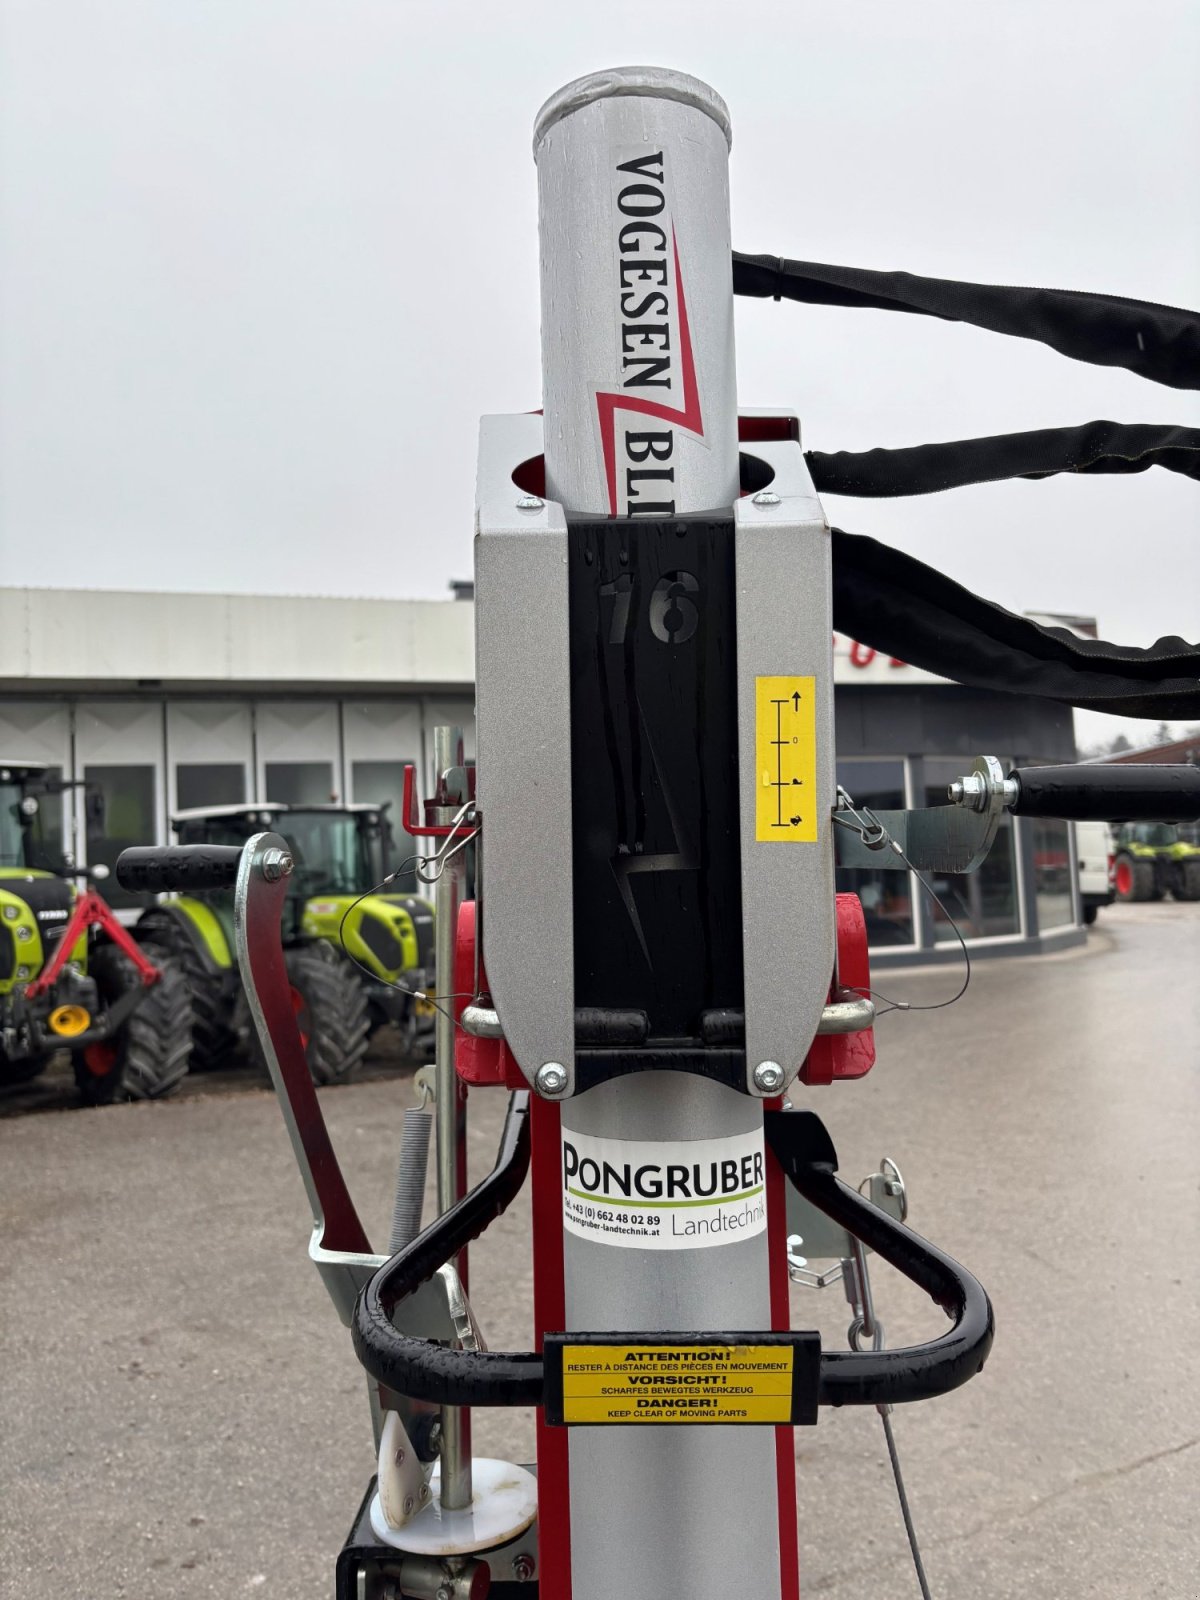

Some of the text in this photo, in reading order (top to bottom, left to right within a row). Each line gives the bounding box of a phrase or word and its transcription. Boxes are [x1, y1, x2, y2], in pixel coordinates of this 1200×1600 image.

[616, 151, 672, 390] VOGESEN
[600, 571, 699, 644] 16
[563, 1140, 763, 1198] PONGRUBER
[572, 1204, 584, 1215] +43
[585, 1207, 596, 1220] (0)
[597, 1210, 614, 1222] 662
[615, 1213, 629, 1224] 48
[631, 1215, 644, 1225] 02
[647, 1216, 660, 1226] 89
[672, 1198, 765, 1237] Landtechnik
[625, 1352, 731, 1361] ATTENTION!
[605, 1363, 611, 1371] À
[613, 1363, 658, 1371] DISTANCE
[661, 1363, 679, 1371] DES
[681, 1362, 713, 1371] PIÈCES
[730, 1362, 788, 1370] MOUVEMENT
[628, 1375, 727, 1385] VORSICHT!
[601, 1386, 754, 1395] SCHARFES BEWEGTES WERKZEUG
[636, 1398, 718, 1408] DANGER!
[608, 1409, 748, 1418] KEEP CLEAR OF MOVING PARTS
